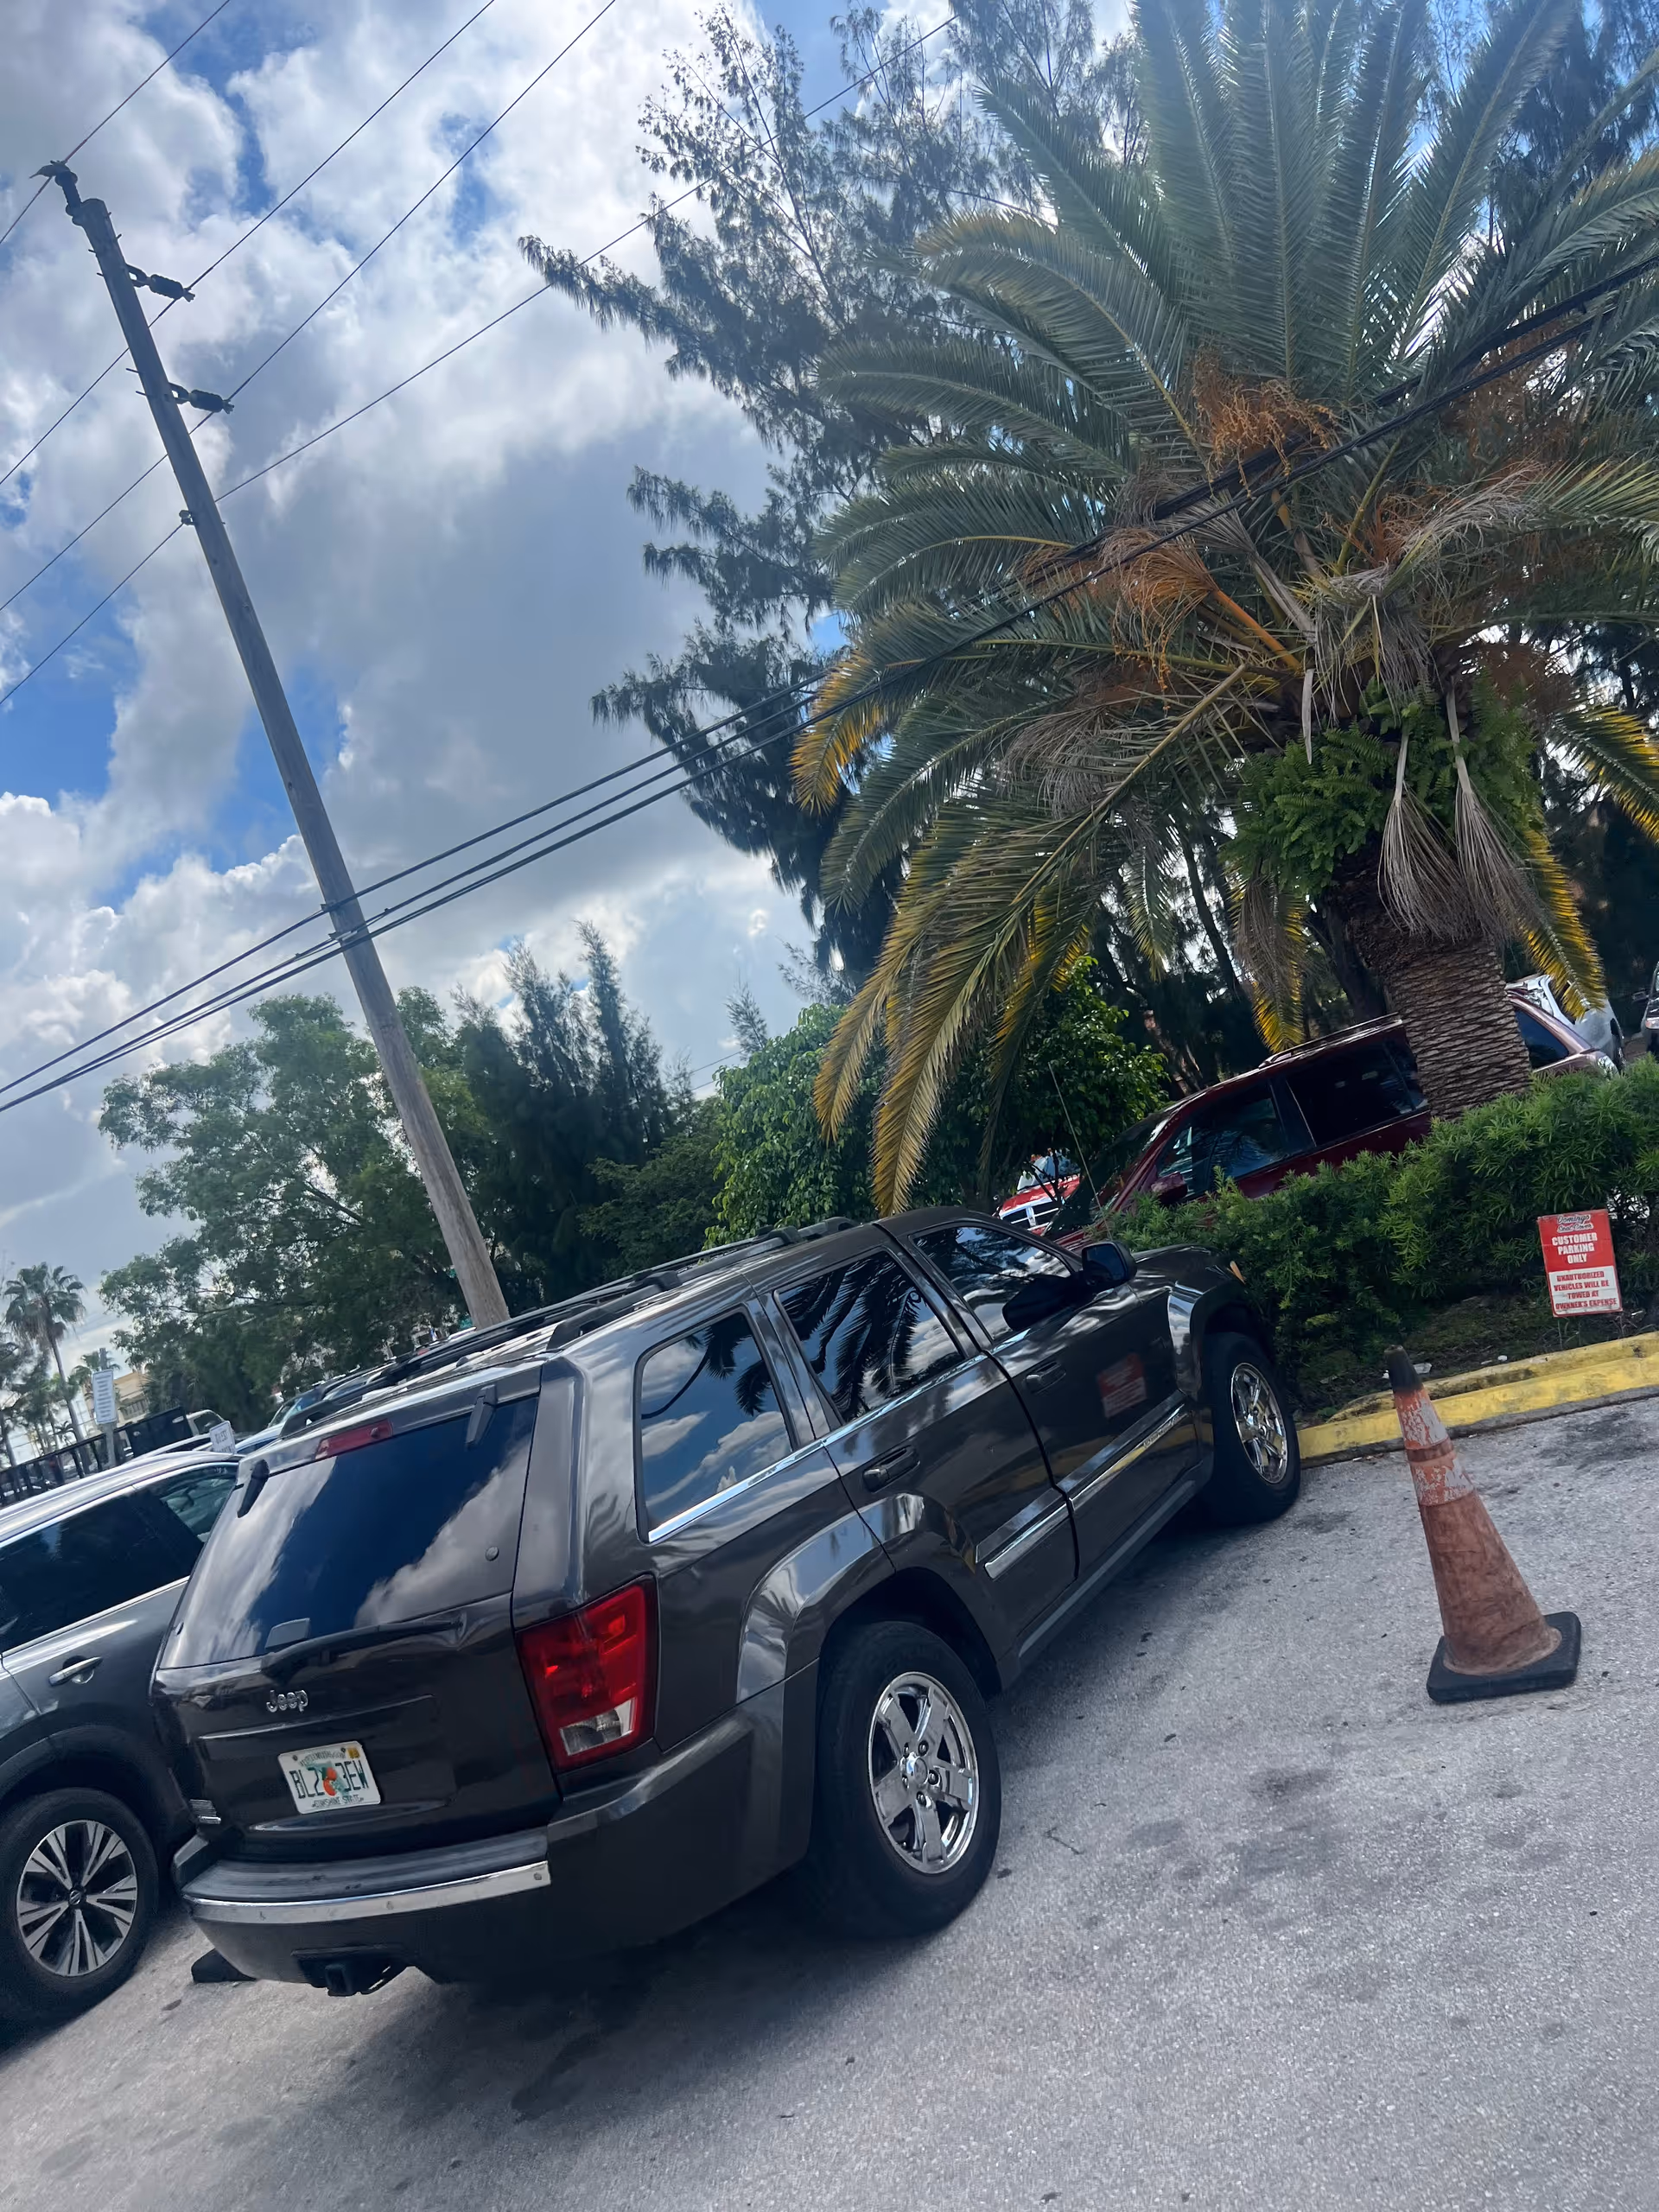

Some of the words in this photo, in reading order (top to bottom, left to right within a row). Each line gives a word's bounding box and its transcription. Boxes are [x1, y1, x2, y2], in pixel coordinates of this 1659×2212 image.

[1552, 1232, 1598, 1246] CUSTOMER
[1558, 1243, 1594, 1255] PARKING
[1567, 1254, 1587, 1264] ONLY
[1556, 1271, 1605, 1281] UNAUTHORIZED
[1554, 1282, 1583, 1291] VEHICLES
[1567, 1291, 1591, 1300] TOWED
[1589, 1298, 1618, 1306] EXPENSE
[266, 1689, 308, 1713] Jeep
